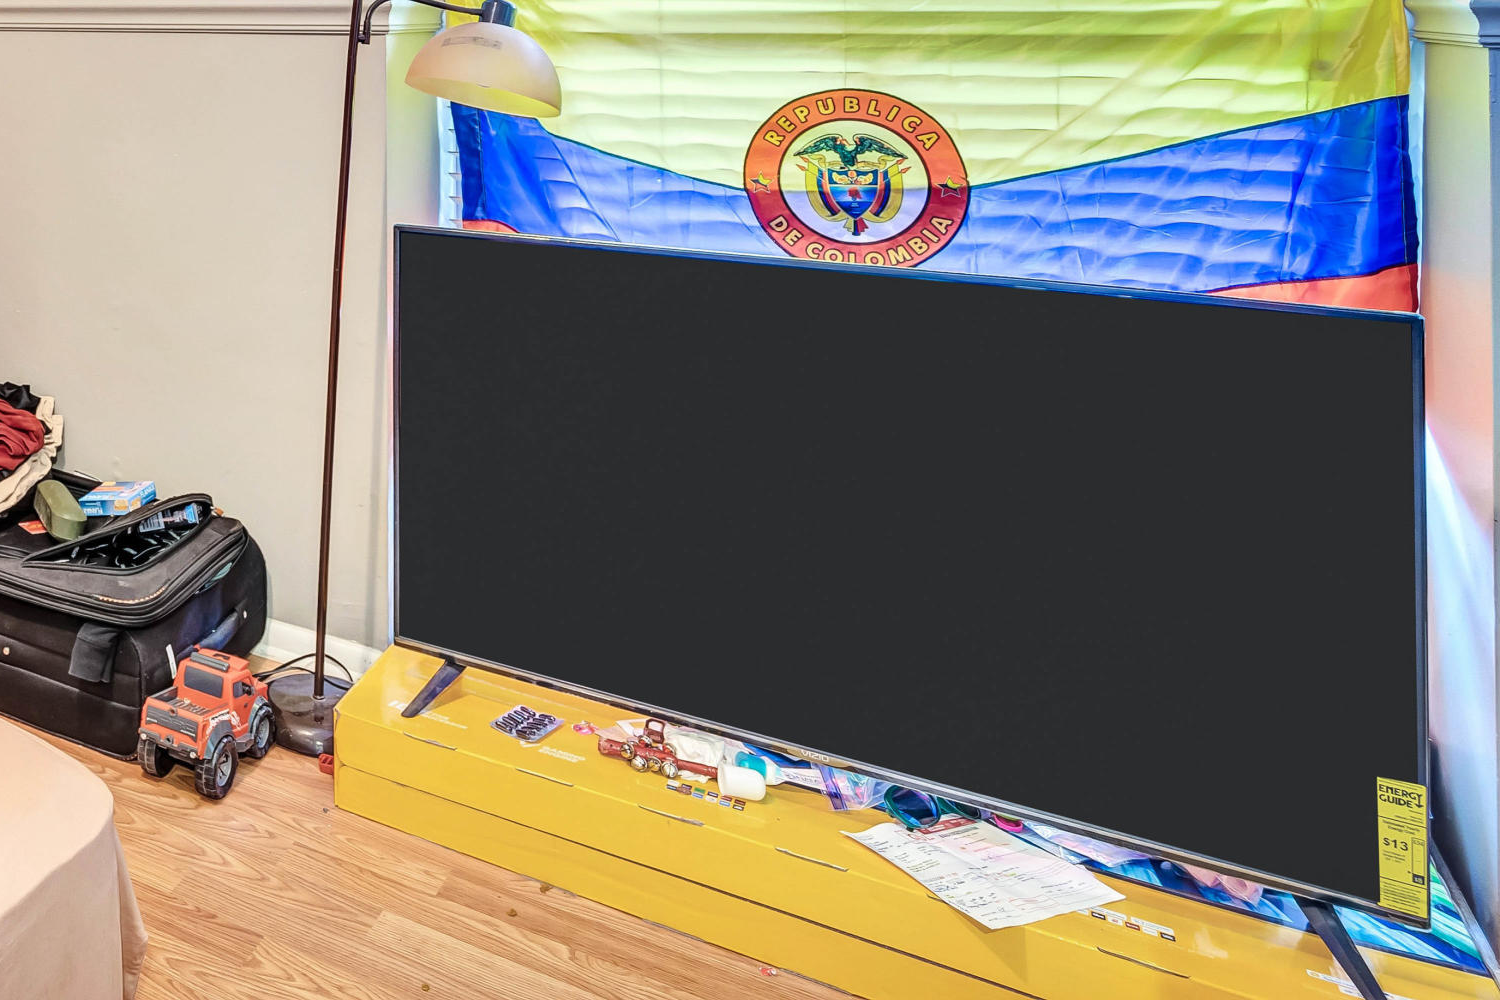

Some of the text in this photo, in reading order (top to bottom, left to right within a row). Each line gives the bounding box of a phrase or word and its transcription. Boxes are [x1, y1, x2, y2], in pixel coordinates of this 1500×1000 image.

[763, 96, 940, 151] REPUBLICA
[768, 214, 954, 266] DE COLOMBIA
[800, 749, 830, 763] VIZIO
[1378, 783, 1423, 806] ENERGY
[1378, 793, 1414, 809] GUIDE
